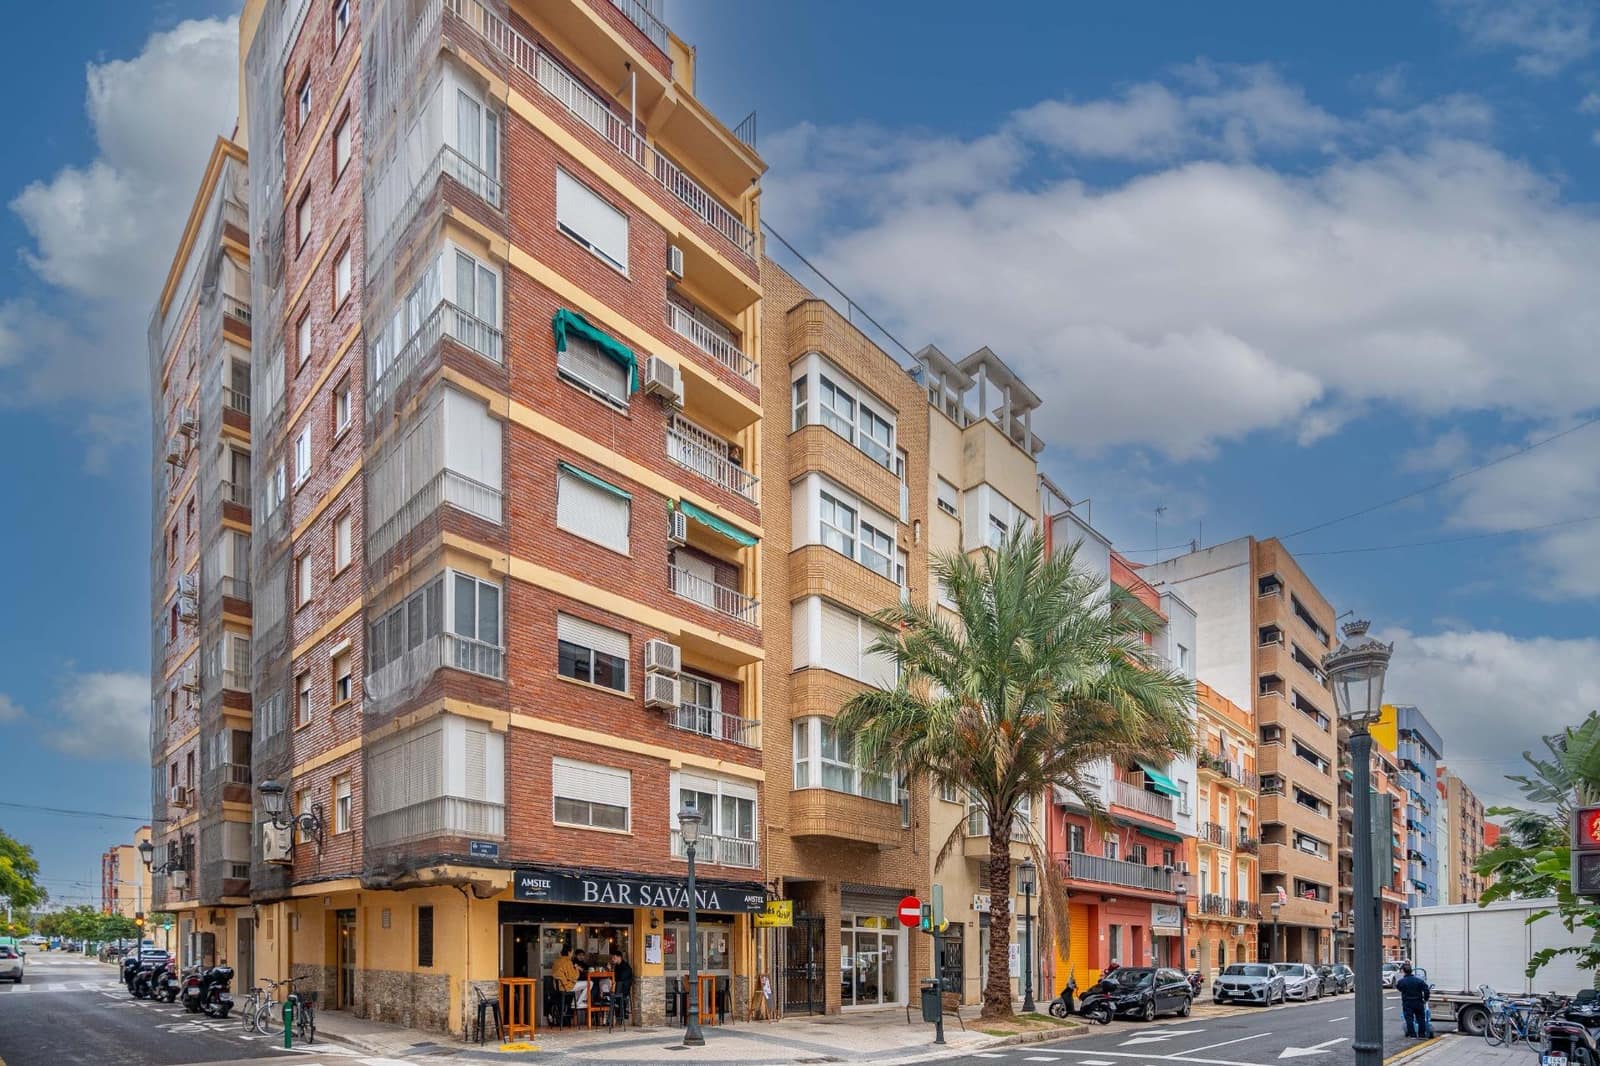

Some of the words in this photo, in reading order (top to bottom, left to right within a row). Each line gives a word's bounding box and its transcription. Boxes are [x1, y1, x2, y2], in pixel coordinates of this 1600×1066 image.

[521, 877, 551, 888] AMSTEL
[582, 880, 634, 905] BAR
[640, 884, 721, 910] SAVANA
[744, 895, 764, 904] AMSTEL
